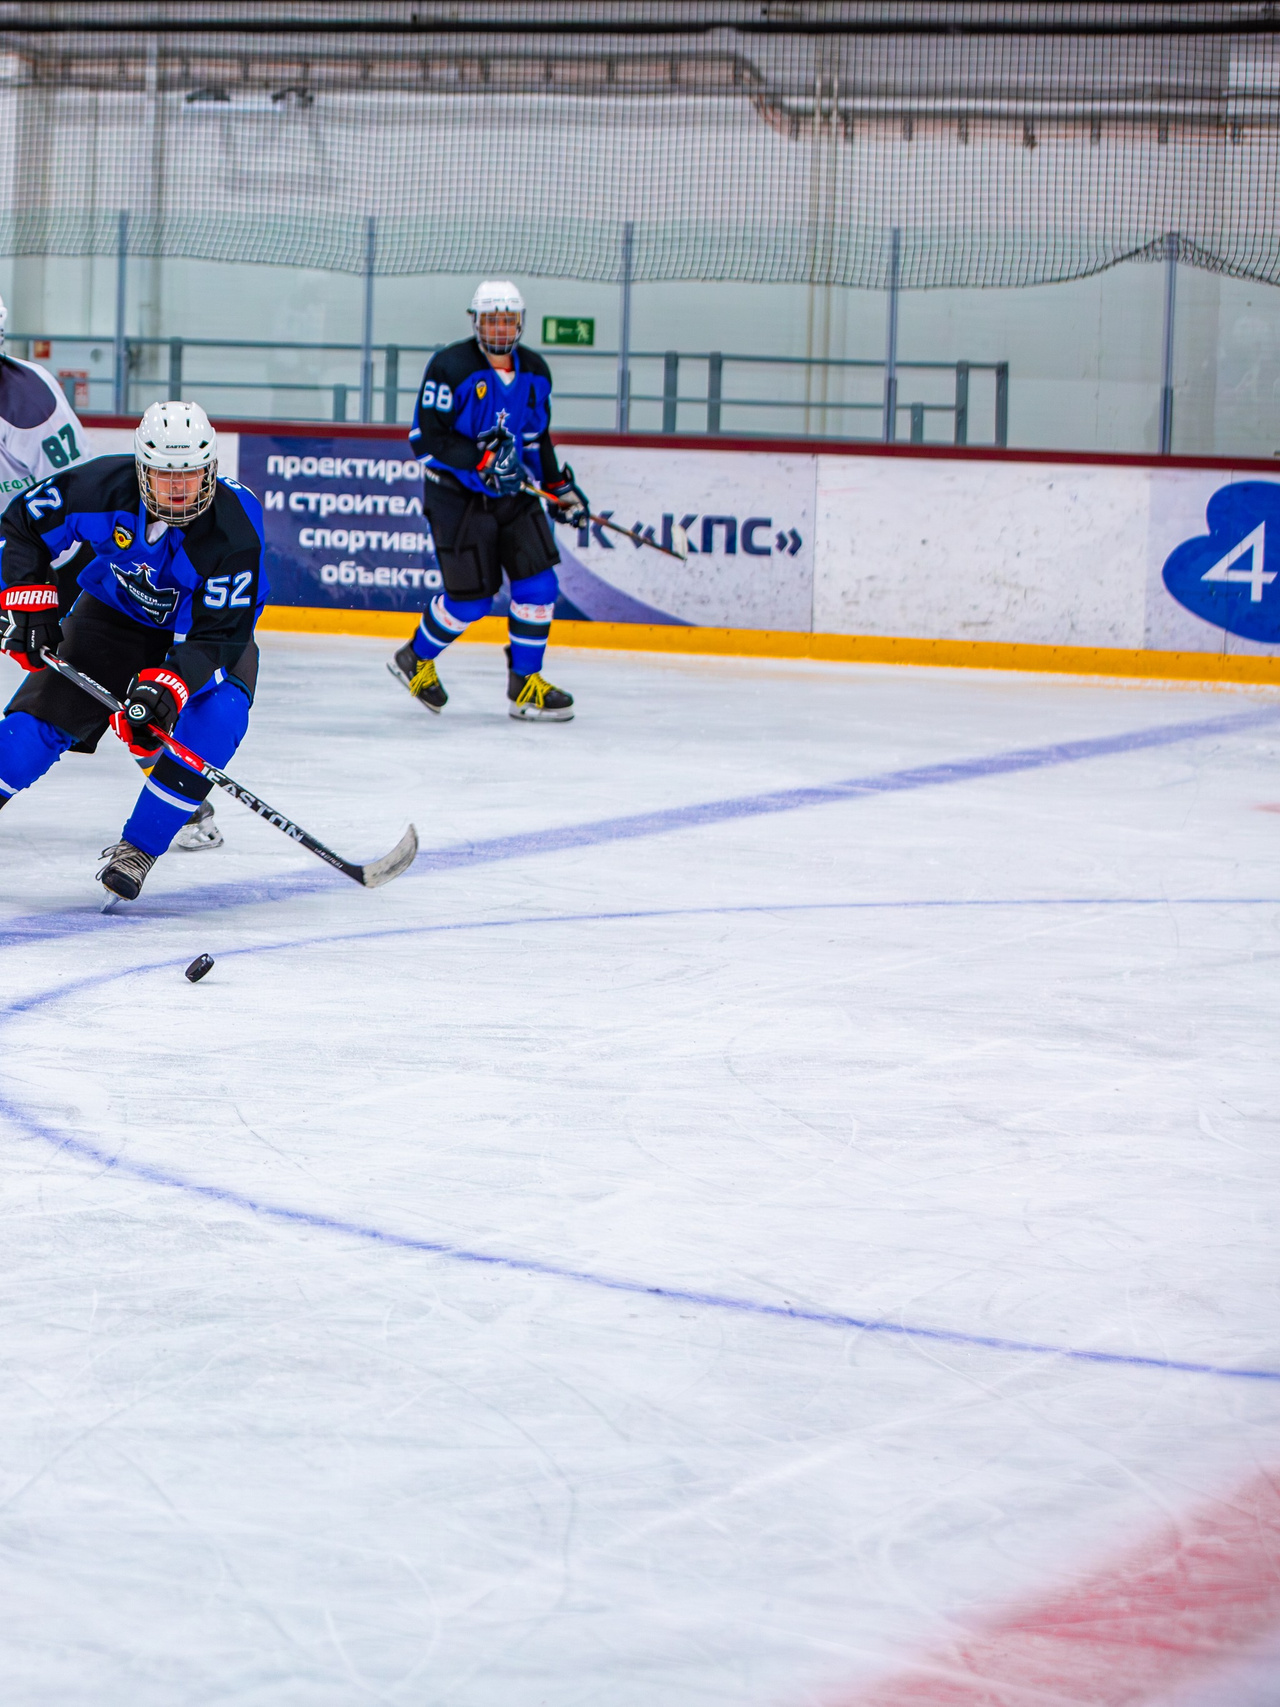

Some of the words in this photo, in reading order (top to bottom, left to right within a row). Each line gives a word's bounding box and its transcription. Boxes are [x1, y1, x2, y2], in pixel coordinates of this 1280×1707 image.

[422, 380, 453, 412] 68
[41, 423, 81, 469] 87
[267, 455, 425, 485] проектиро
[264, 490, 285, 512] и
[1200, 520, 1279, 603] 4
[5, 590, 59, 606] WARRI
[204, 570, 252, 608] 52
[154, 672, 189, 708] WAR
[205, 766, 306, 842] EASTON
